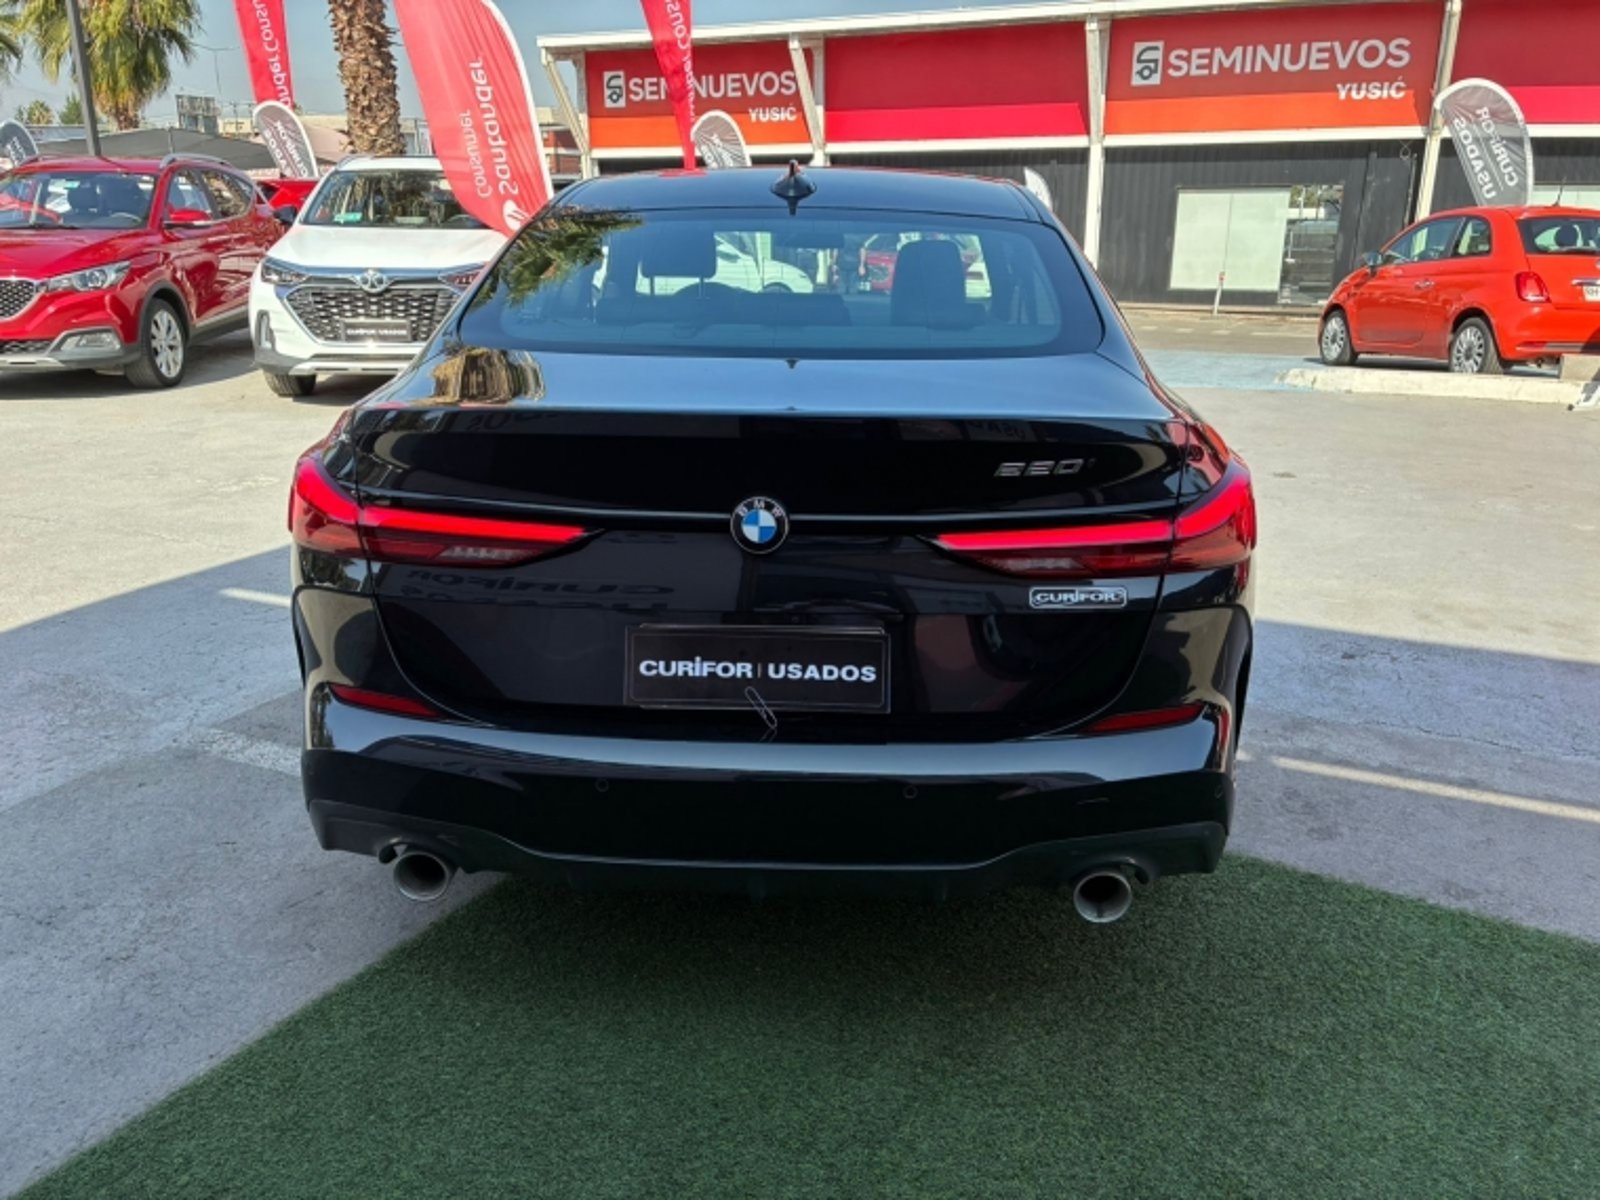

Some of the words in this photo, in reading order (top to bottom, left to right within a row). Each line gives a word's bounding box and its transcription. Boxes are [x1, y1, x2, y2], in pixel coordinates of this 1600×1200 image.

[1167, 37, 1411, 78] SEMINUEVOS
[629, 70, 798, 102] SENUEVOS
[1336, 76, 1407, 100] YUSIĆ
[767, 663, 877, 683] USADOS
